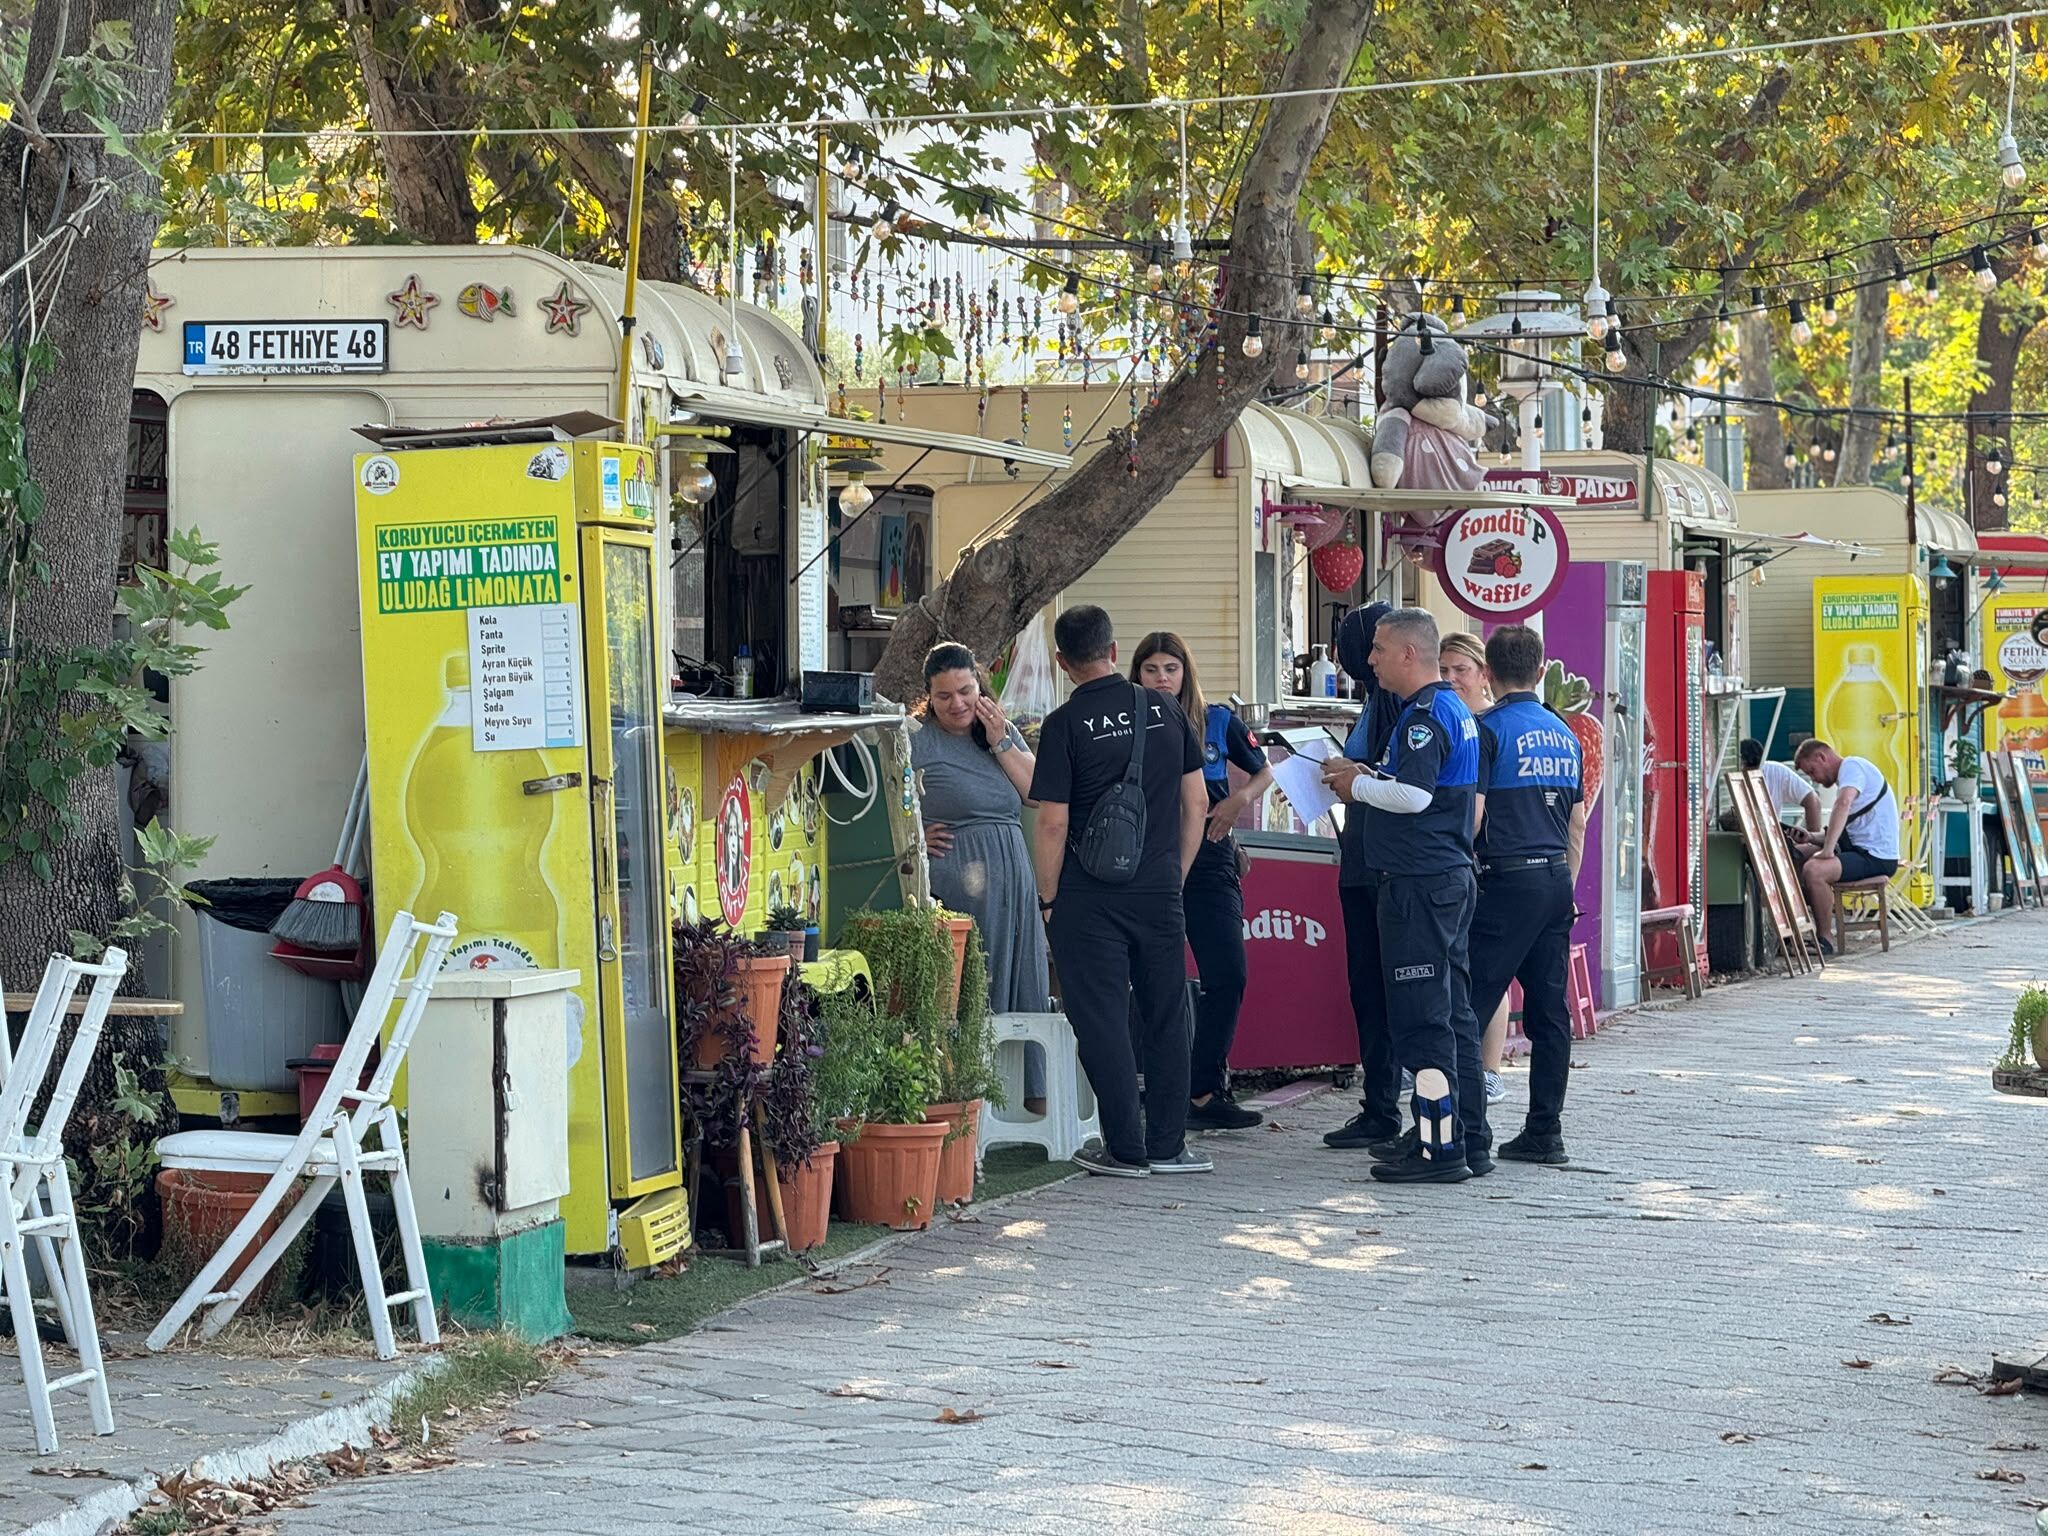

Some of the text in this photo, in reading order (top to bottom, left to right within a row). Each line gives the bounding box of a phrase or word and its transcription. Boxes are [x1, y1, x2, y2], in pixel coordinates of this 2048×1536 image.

[188, 341, 204, 354] TR
[211, 330, 240, 359] 48
[346, 329, 376, 358] 48
[379, 525, 465, 548] KORUYUCU
[380, 543, 557, 579] EV YAPIMI TADINDA
[381, 577, 451, 611] ULUDAĞ
[1462, 576, 1532, 603] waffle
[479, 615, 497, 625] Kola
[480, 630, 503, 640] Fanta
[481, 644, 506, 656] Sprite
[482, 657, 533, 671] Ayran Küçük
[483, 672, 534, 685] Ayran Büyük
[483, 688, 514, 700] Şalgam
[483, 702, 504, 712] Soda
[484, 716, 532, 729] Meyve Suyu
[1083, 705, 1161, 732] YACT
[485, 731, 496, 741] Su
[1518, 757, 1578, 778] ZABITA
[1399, 967, 1430, 978] ZABITA
